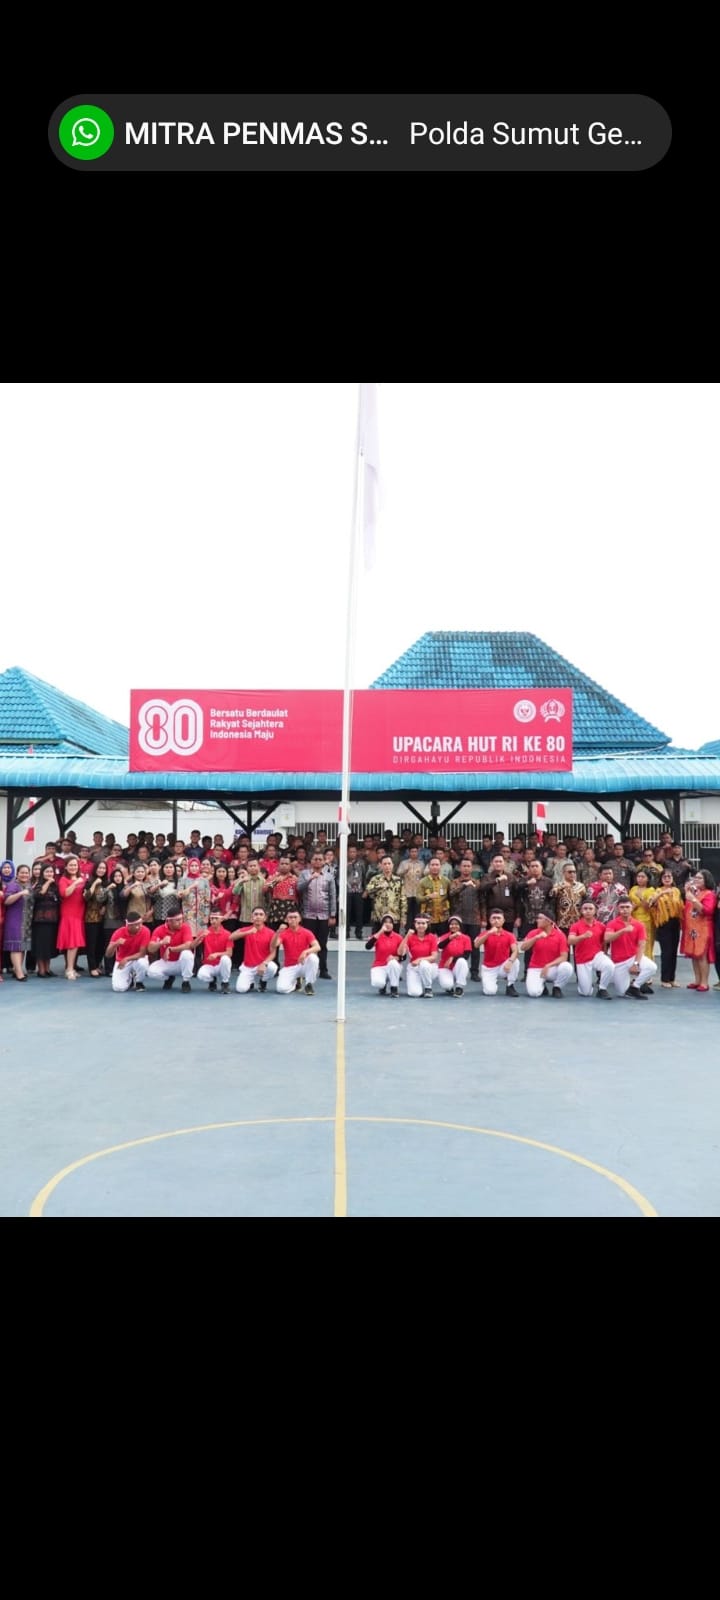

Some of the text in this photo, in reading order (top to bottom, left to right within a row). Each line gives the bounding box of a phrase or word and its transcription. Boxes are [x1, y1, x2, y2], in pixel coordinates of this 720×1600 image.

[210, 708, 289, 718] Bersatu Berdaulat
[210, 719, 284, 729] Rakyat Sejahtera
[210, 730, 274, 741] Indonesia Maju
[393, 736, 565, 752] UPACARA HUT RI KE 80
[393, 755, 566, 763] DIRGAHAYU REPUBLIK INDONESIA
